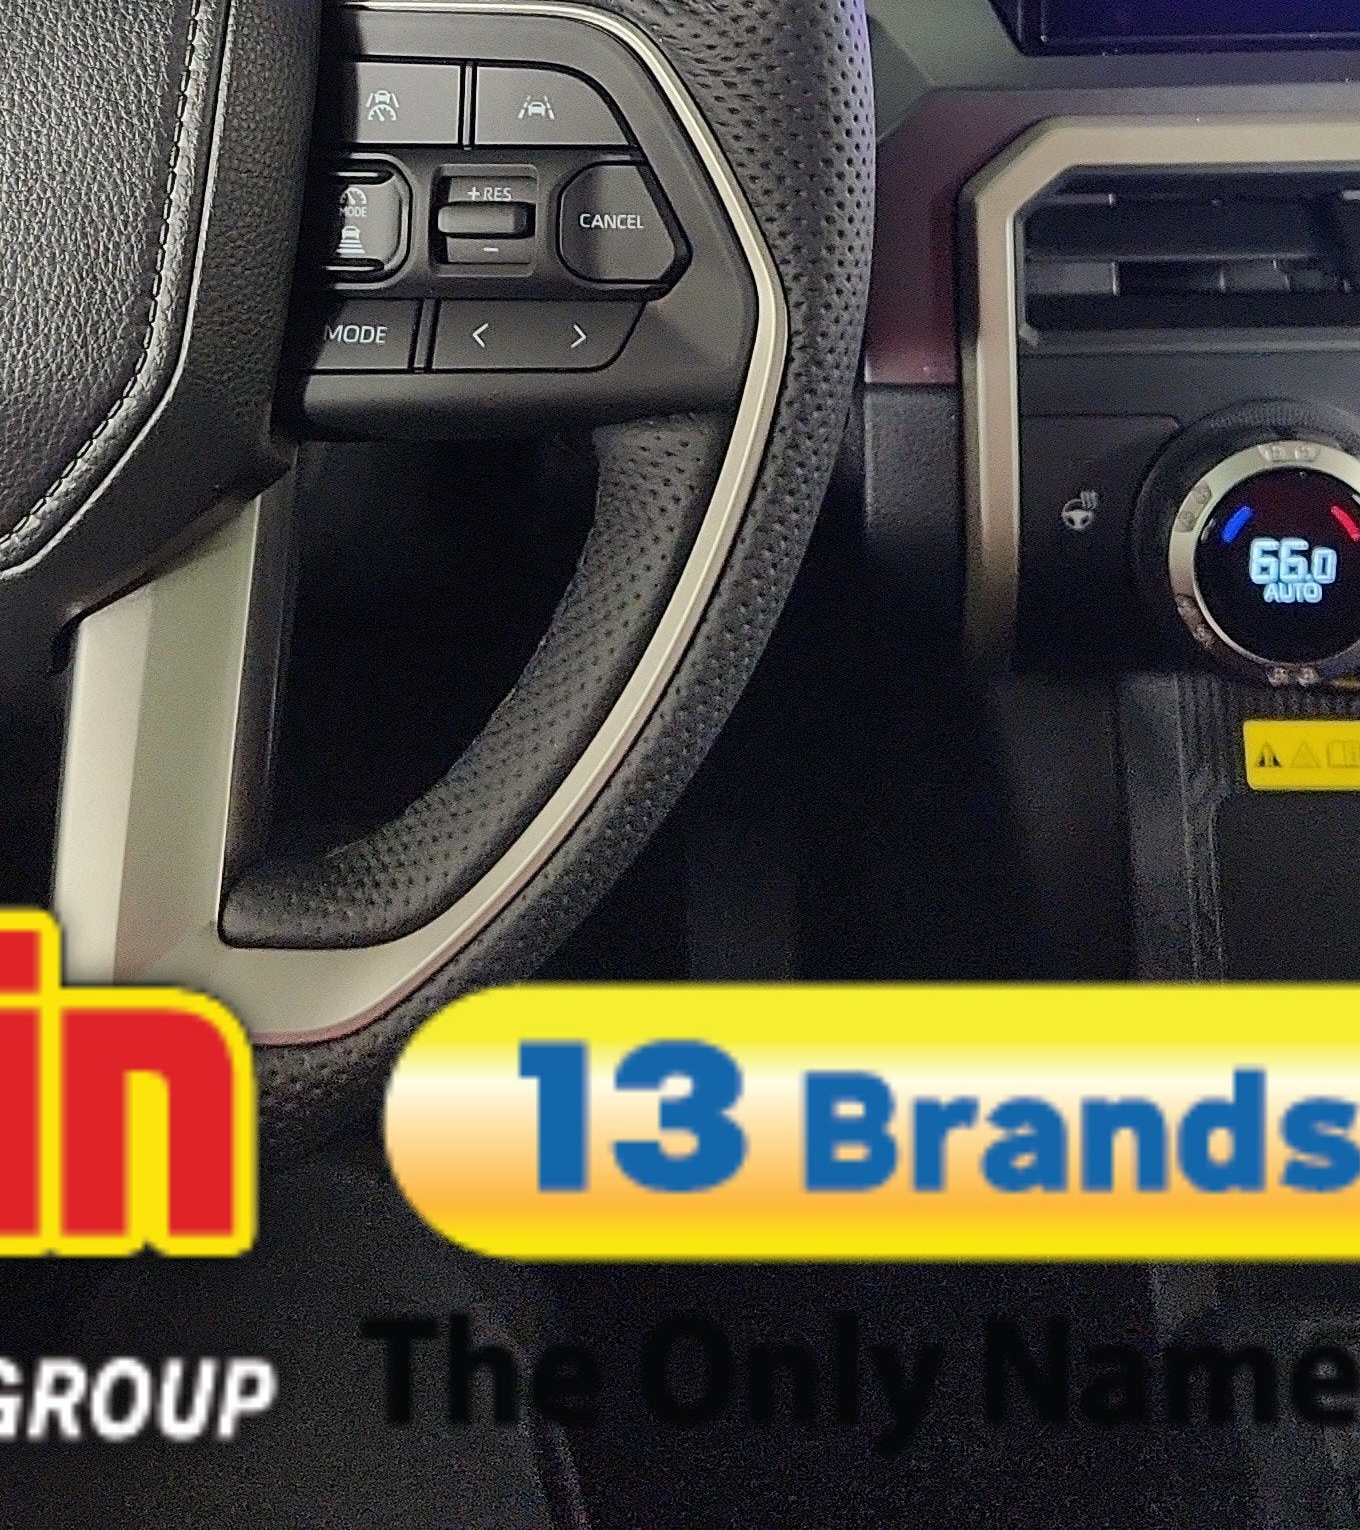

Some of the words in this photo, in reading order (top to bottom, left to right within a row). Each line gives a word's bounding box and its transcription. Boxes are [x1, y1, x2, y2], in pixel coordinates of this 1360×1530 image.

[579, 212, 645, 231] CANCEL
[324, 324, 388, 345] MODE
[1248, 536, 1338, 585] 66.0
[1263, 582, 1324, 604] AUTO
